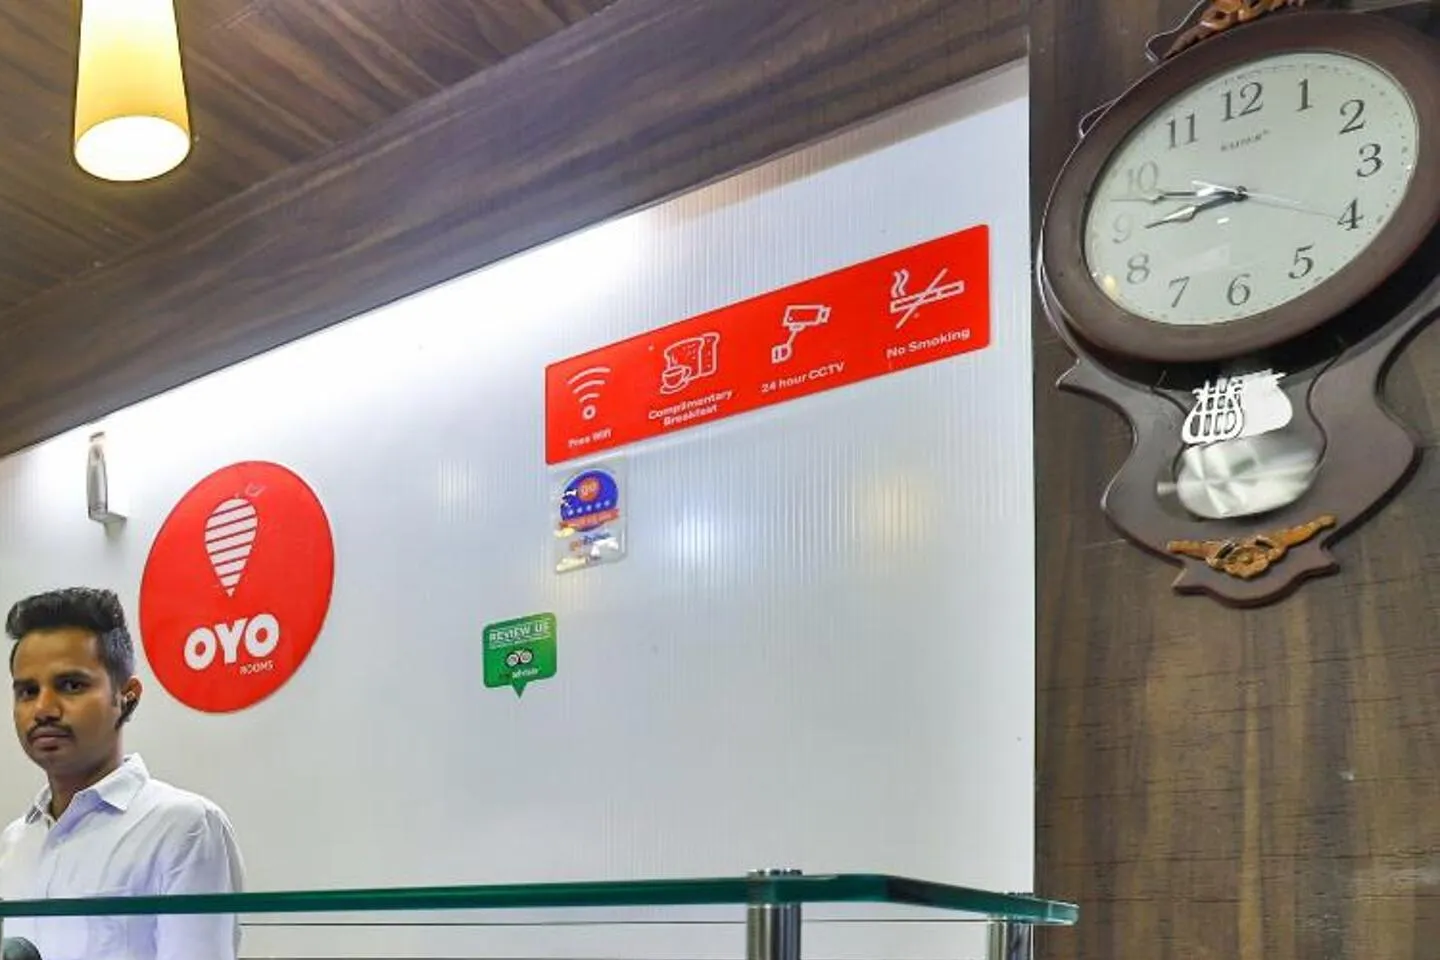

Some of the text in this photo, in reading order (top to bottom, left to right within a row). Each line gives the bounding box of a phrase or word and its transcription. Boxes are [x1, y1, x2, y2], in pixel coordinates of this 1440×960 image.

[1220, 82, 1264, 122] 12
[1296, 79, 1314, 112] 1
[1166, 113, 1199, 149] 11
[1338, 99, 1366, 135] 2
[1127, 160, 1160, 193] 10
[1356, 143, 1383, 178] 3
[1112, 214, 1133, 244] 9
[1337, 199, 1364, 231] 4
[1126, 253, 1151, 285] 8
[1288, 245, 1315, 280] 5
[1168, 276, 1191, 308] 7
[1226, 273, 1253, 306] 6
[886, 328, 971, 359] No Smoking
[761, 361, 845, 394] 24 hour CCTV
[647, 389, 733, 420] Complimentary
[183, 613, 281, 672] OYO
